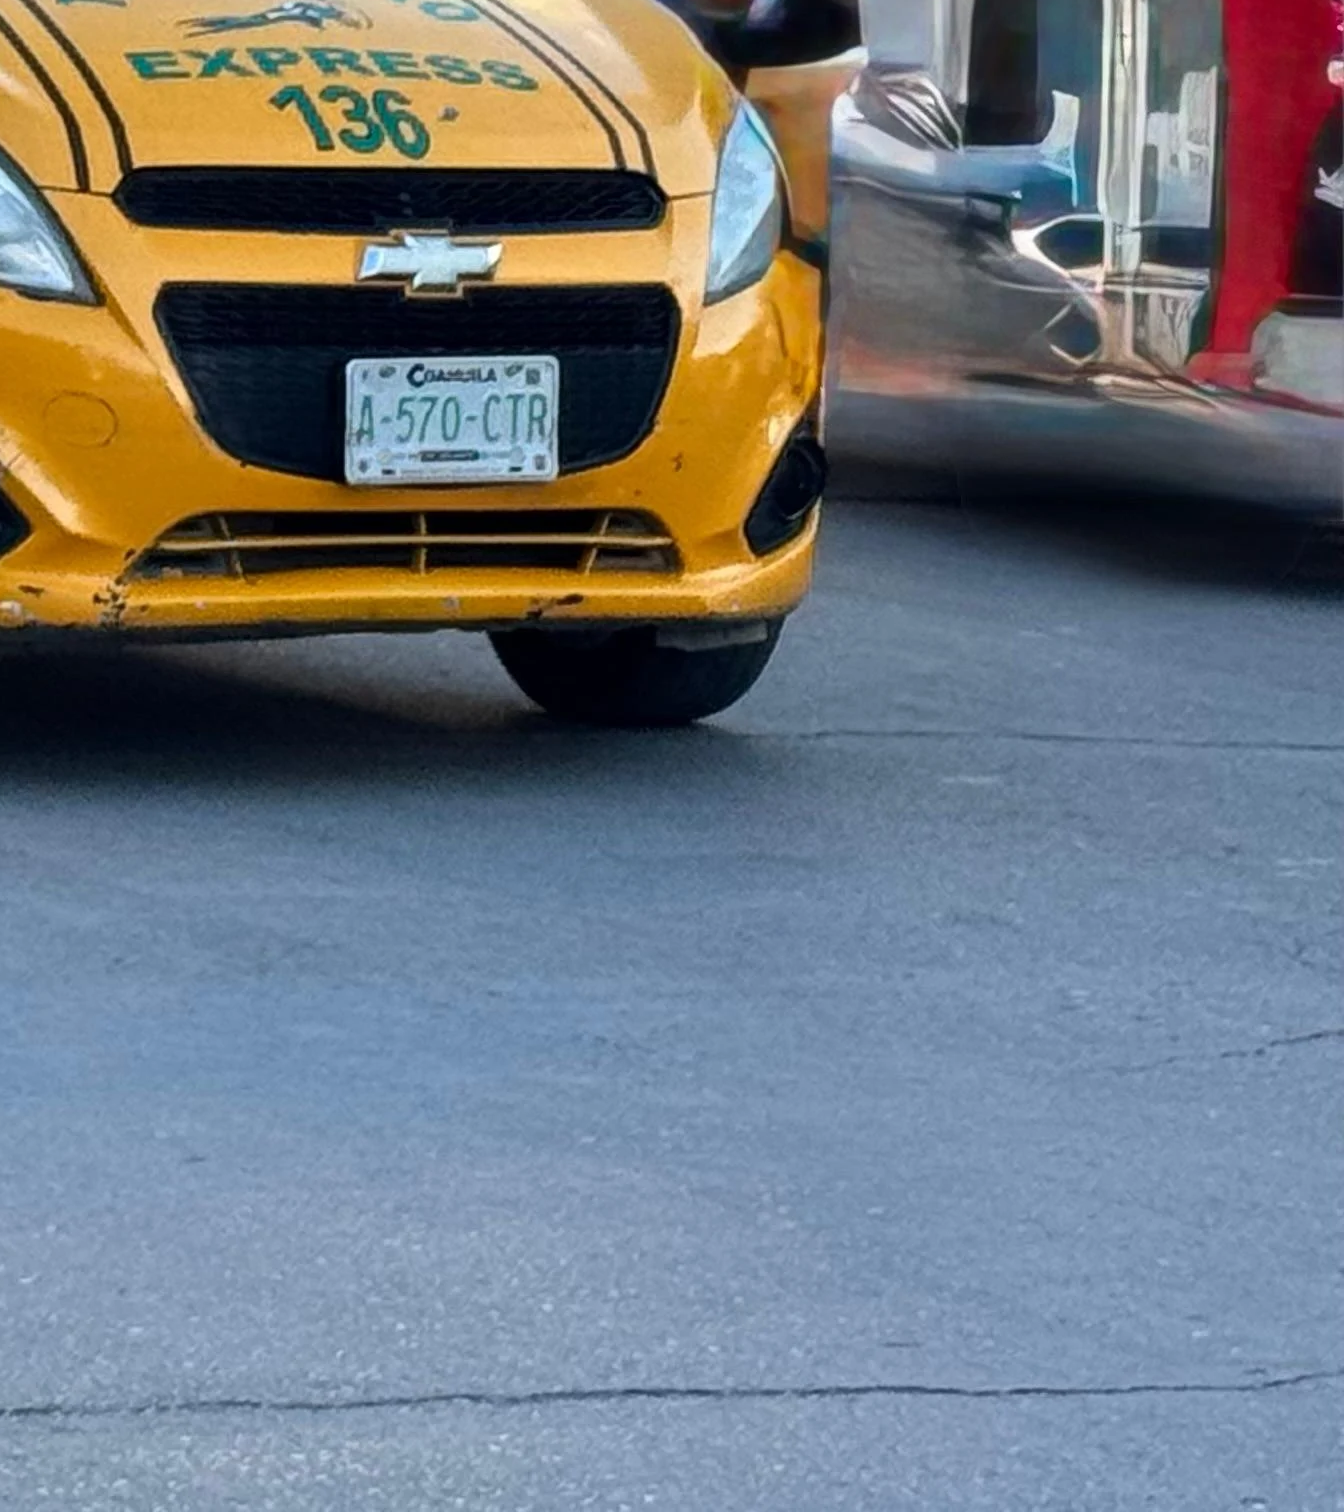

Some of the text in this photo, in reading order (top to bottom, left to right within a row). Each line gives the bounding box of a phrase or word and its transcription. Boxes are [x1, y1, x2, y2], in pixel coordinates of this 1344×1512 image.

[124, 45, 540, 91] EXPRESS
[269, 84, 430, 160] 136
[356, 393, 549, 444] A-570-CTR
